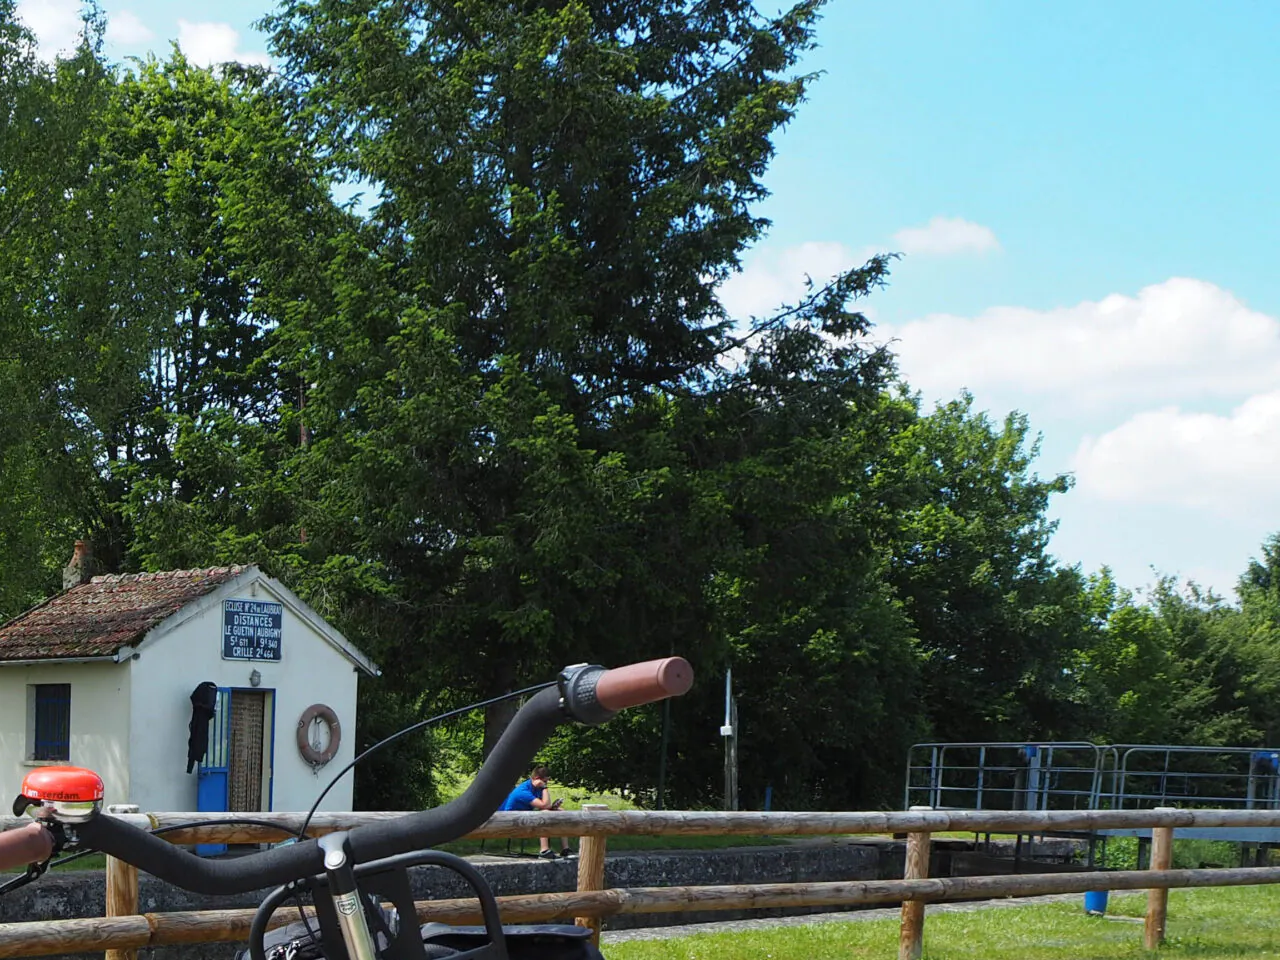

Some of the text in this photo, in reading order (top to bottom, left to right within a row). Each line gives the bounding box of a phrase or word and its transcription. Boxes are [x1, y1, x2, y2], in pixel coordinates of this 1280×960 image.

[234, 615, 273, 628] DISTANCES
[225, 625, 232, 636] LE
[257, 627, 281, 639] AUBIGNY
